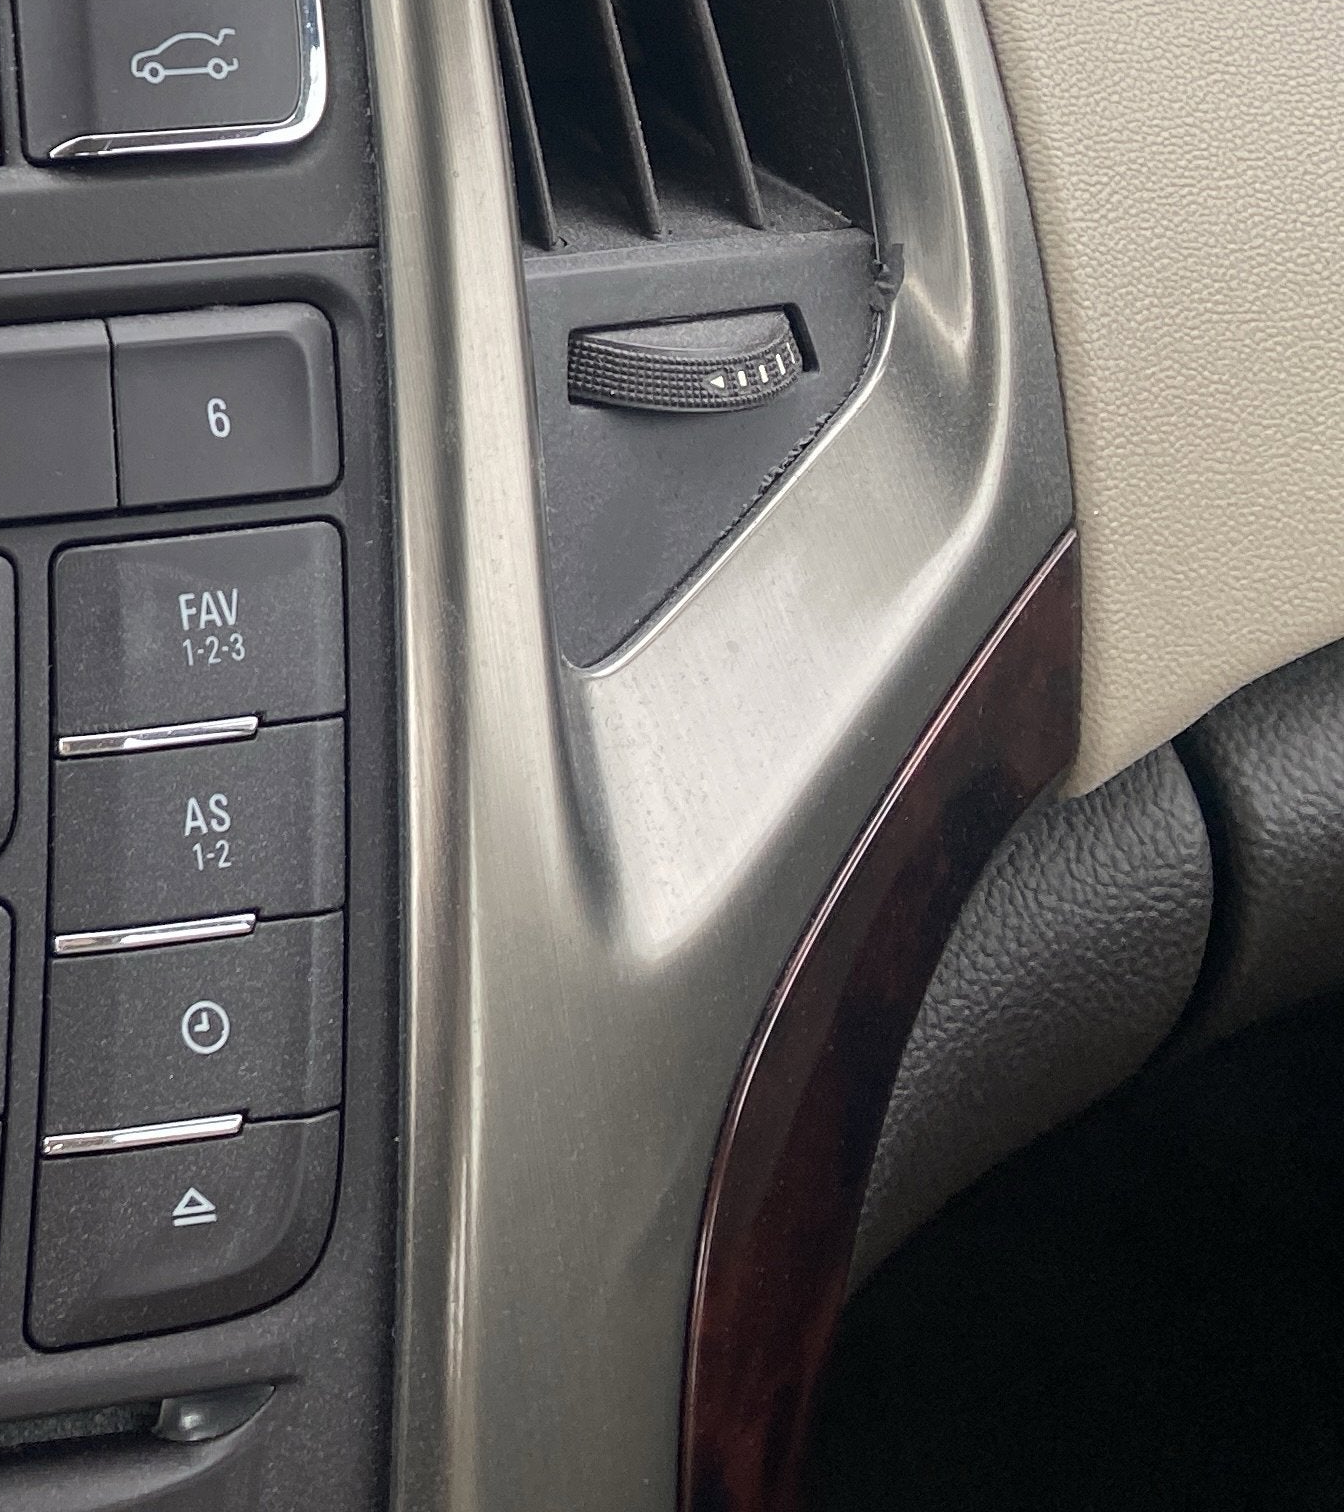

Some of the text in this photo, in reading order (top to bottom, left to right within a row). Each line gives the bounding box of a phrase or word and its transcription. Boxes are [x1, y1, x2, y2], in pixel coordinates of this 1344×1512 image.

[207, 398, 231, 438] 6
[178, 588, 241, 632] FAV
[182, 635, 246, 666] 1-2-3
[184, 793, 231, 837] AS
[192, 839, 232, 871] 1-2
